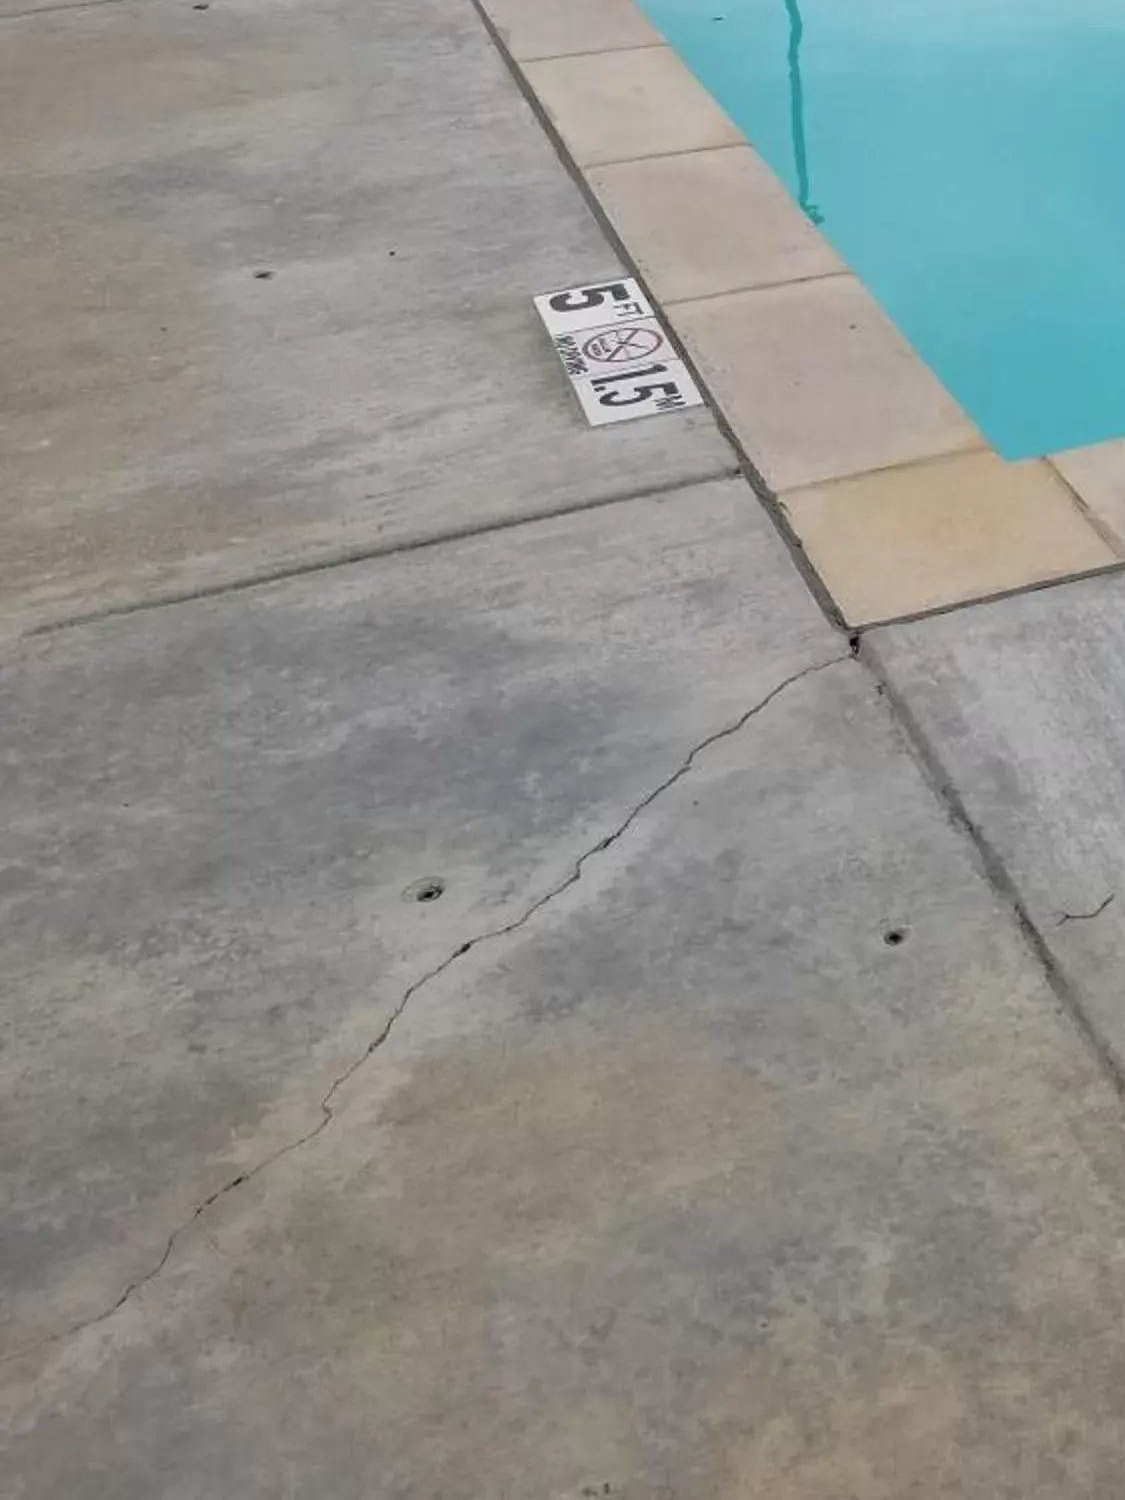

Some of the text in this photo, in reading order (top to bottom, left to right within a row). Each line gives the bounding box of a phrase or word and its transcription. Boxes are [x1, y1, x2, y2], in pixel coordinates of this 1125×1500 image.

[550, 283, 644, 317] 5 FT
[590, 364, 679, 407] 1.5
